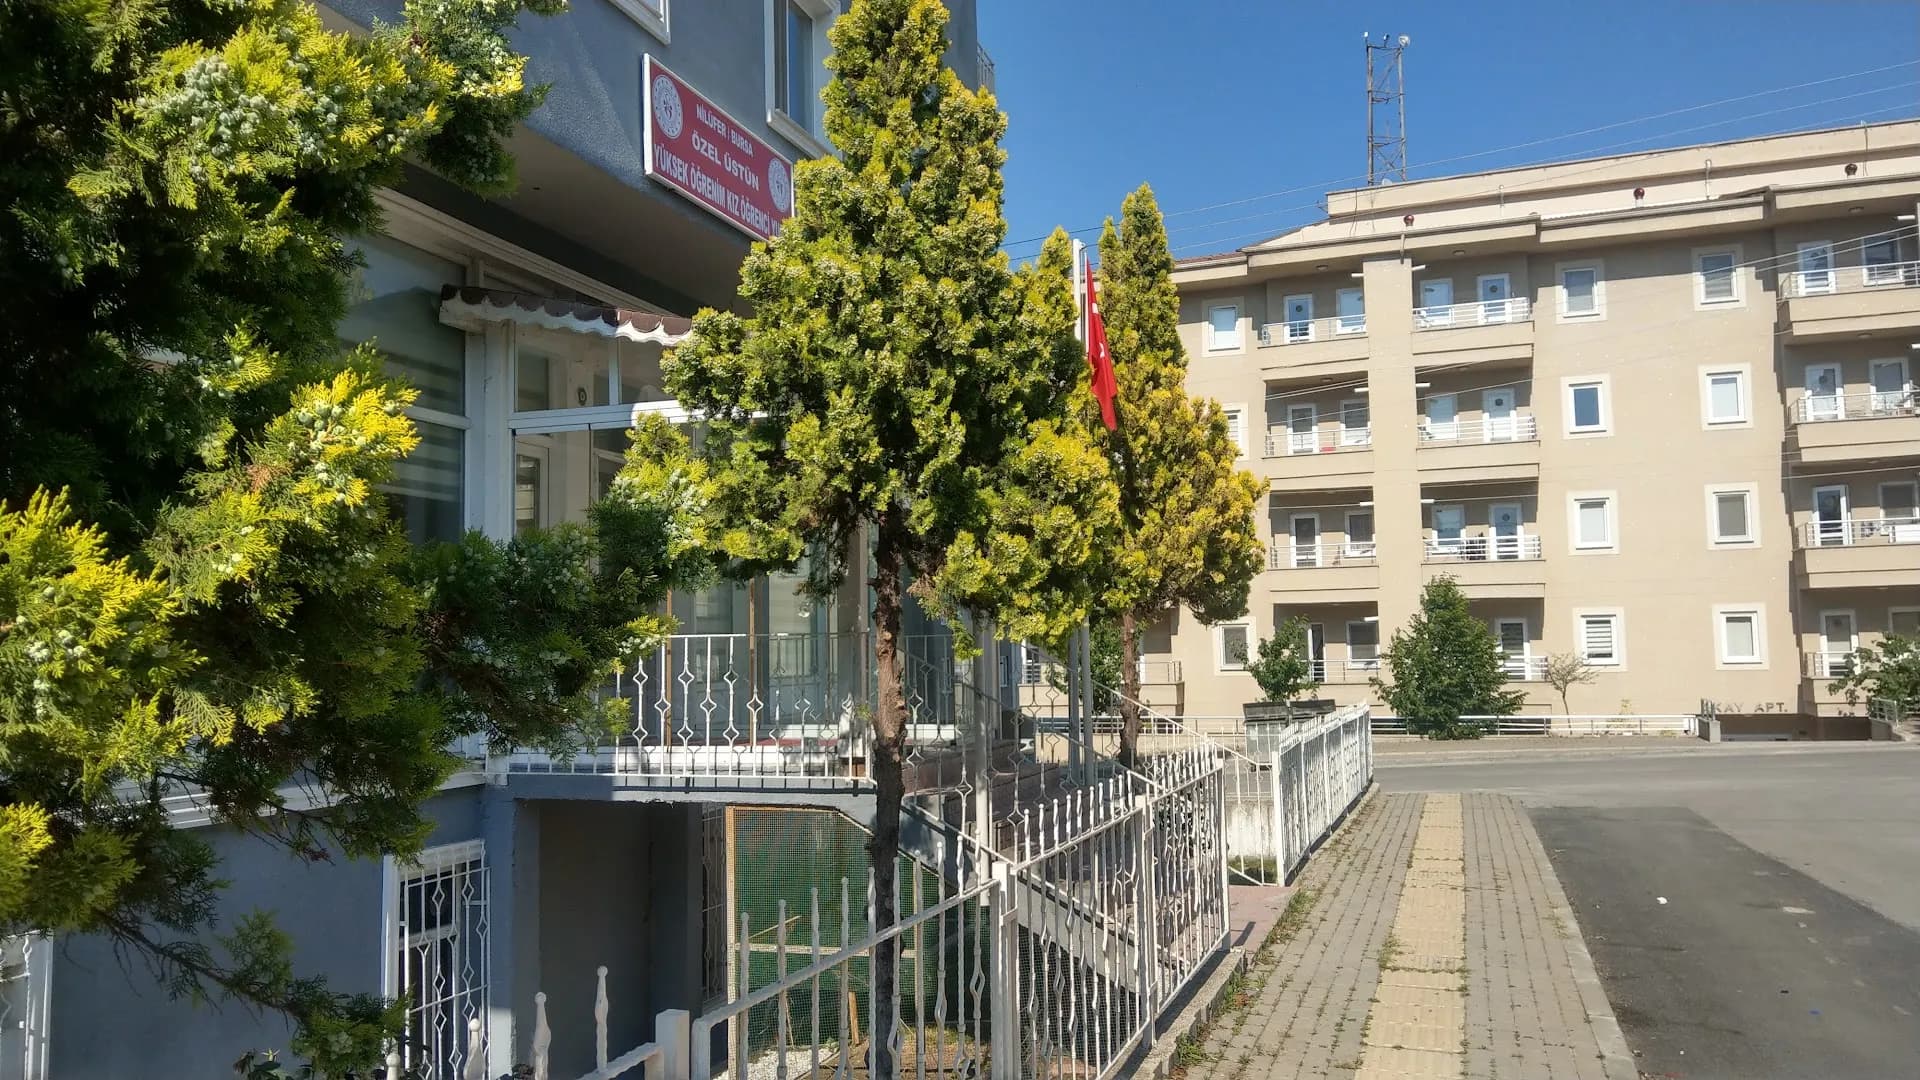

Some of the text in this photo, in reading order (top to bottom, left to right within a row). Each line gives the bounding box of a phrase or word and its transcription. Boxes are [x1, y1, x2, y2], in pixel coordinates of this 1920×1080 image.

[692, 129, 760, 191] ÖZEL ÜSTÜN
[731, 130, 754, 157] BURSA
[654, 143, 689, 186] YÜKSEK
[690, 162, 726, 207] ÖĞRENİM
[726, 191, 739, 216] KIZ
[740, 195, 771, 235] ÖĞRENCİ
